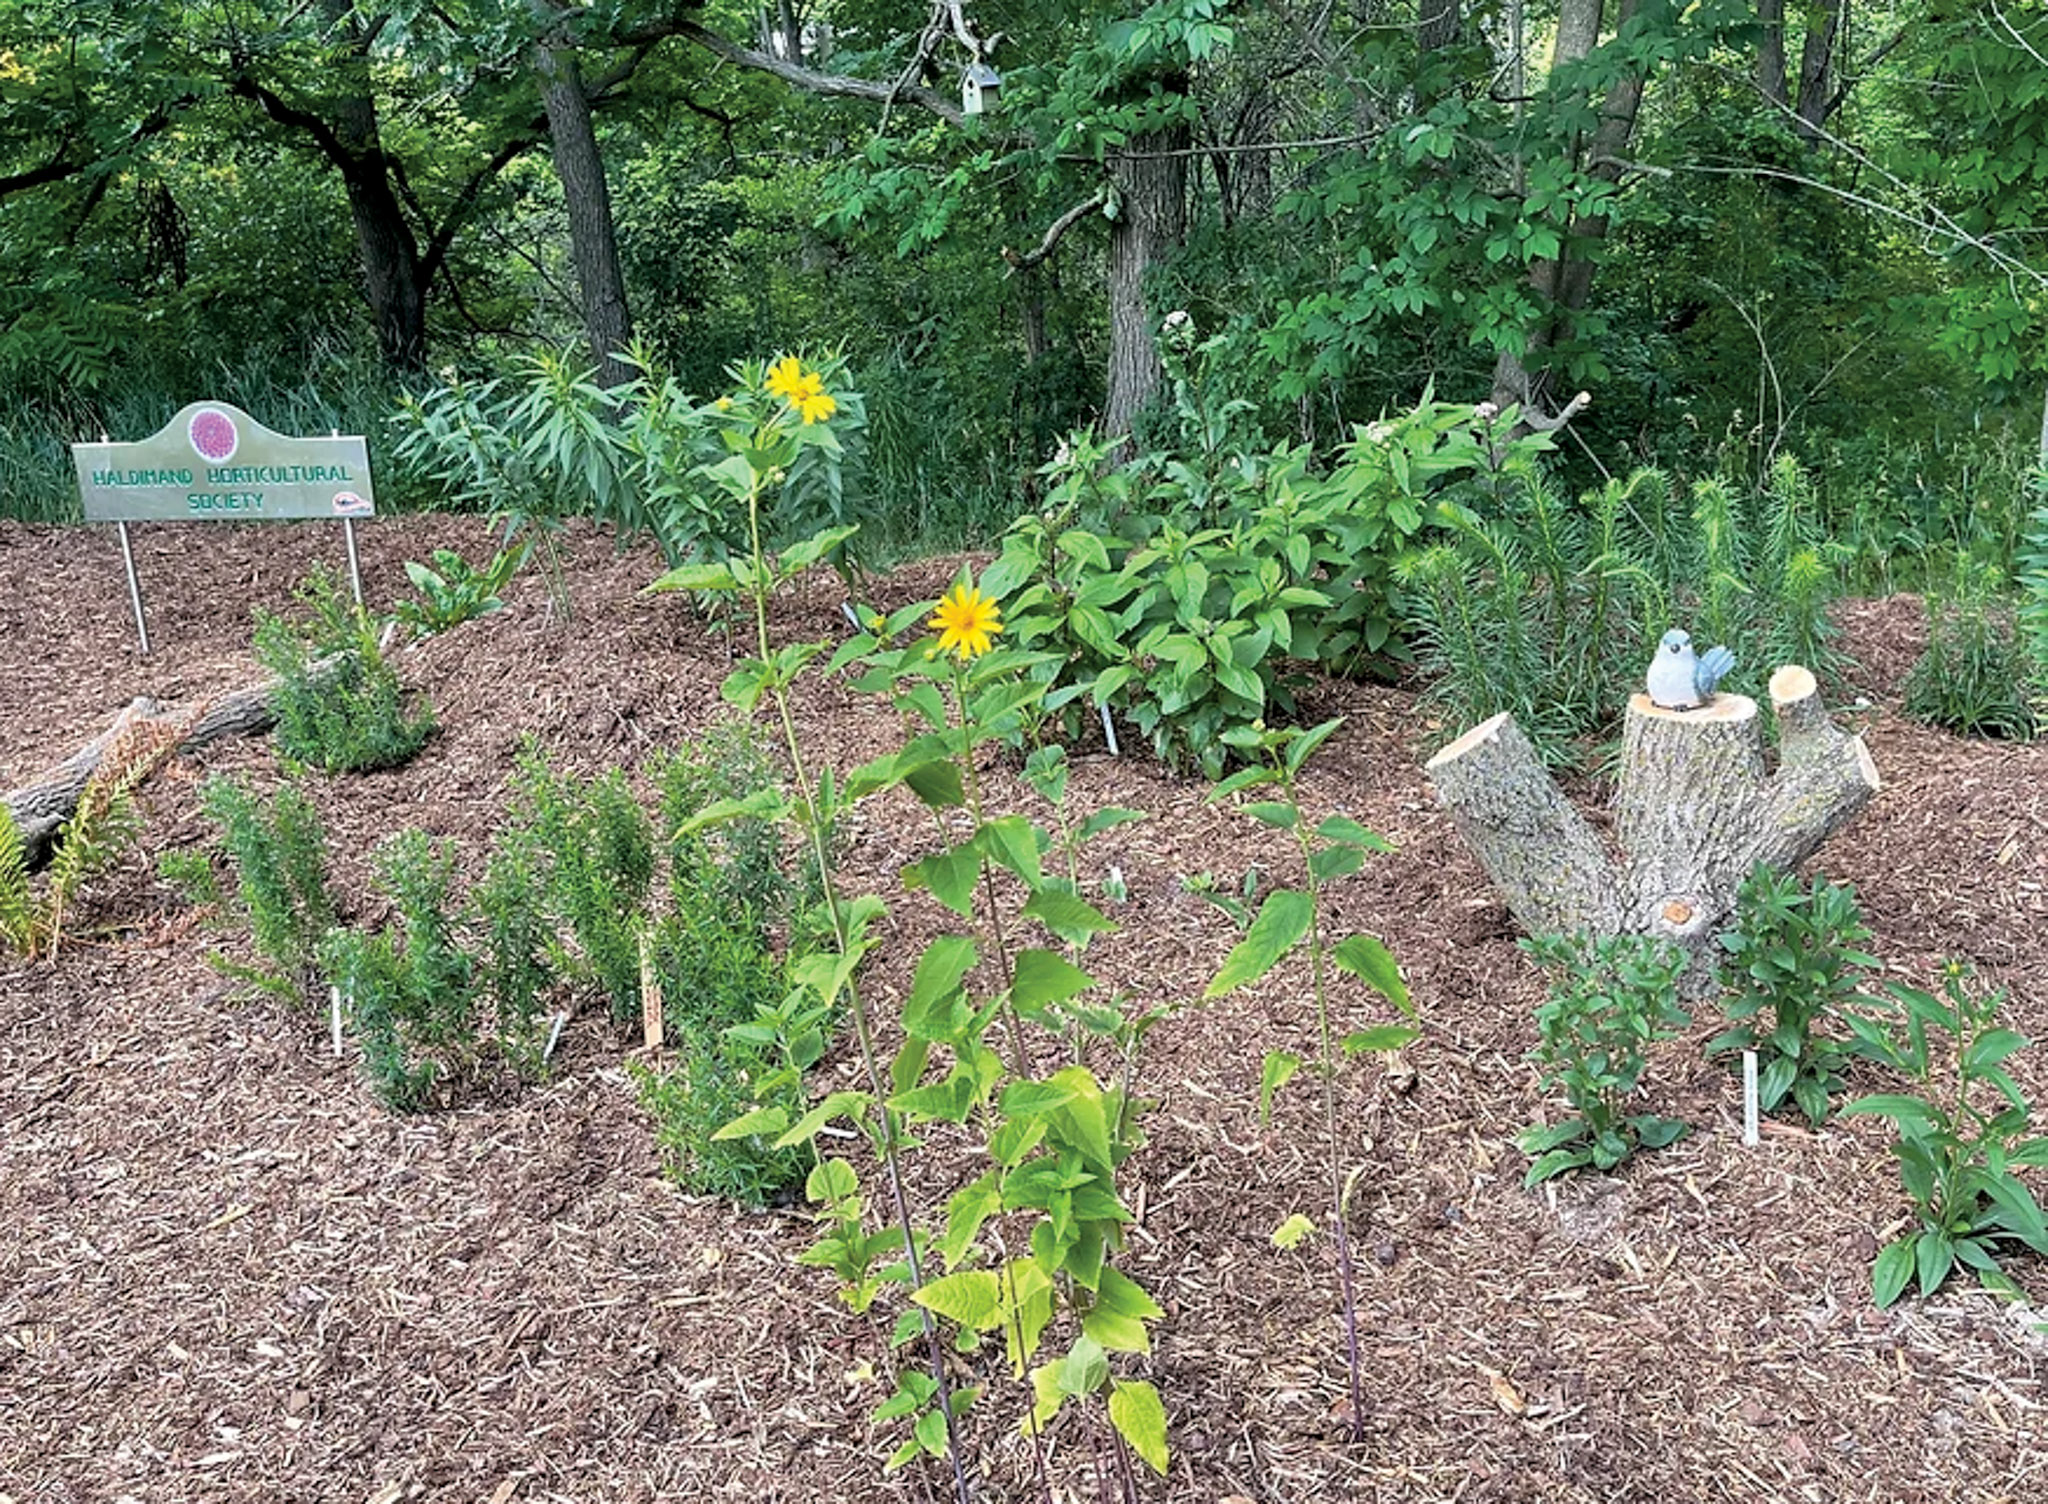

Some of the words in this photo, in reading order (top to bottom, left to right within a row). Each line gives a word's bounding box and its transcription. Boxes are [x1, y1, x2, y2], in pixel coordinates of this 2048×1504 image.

[93, 469, 193, 486] HALDIMAND
[207, 465, 353, 483] HORTICULTURAL
[187, 493, 263, 510] SOCIETY
